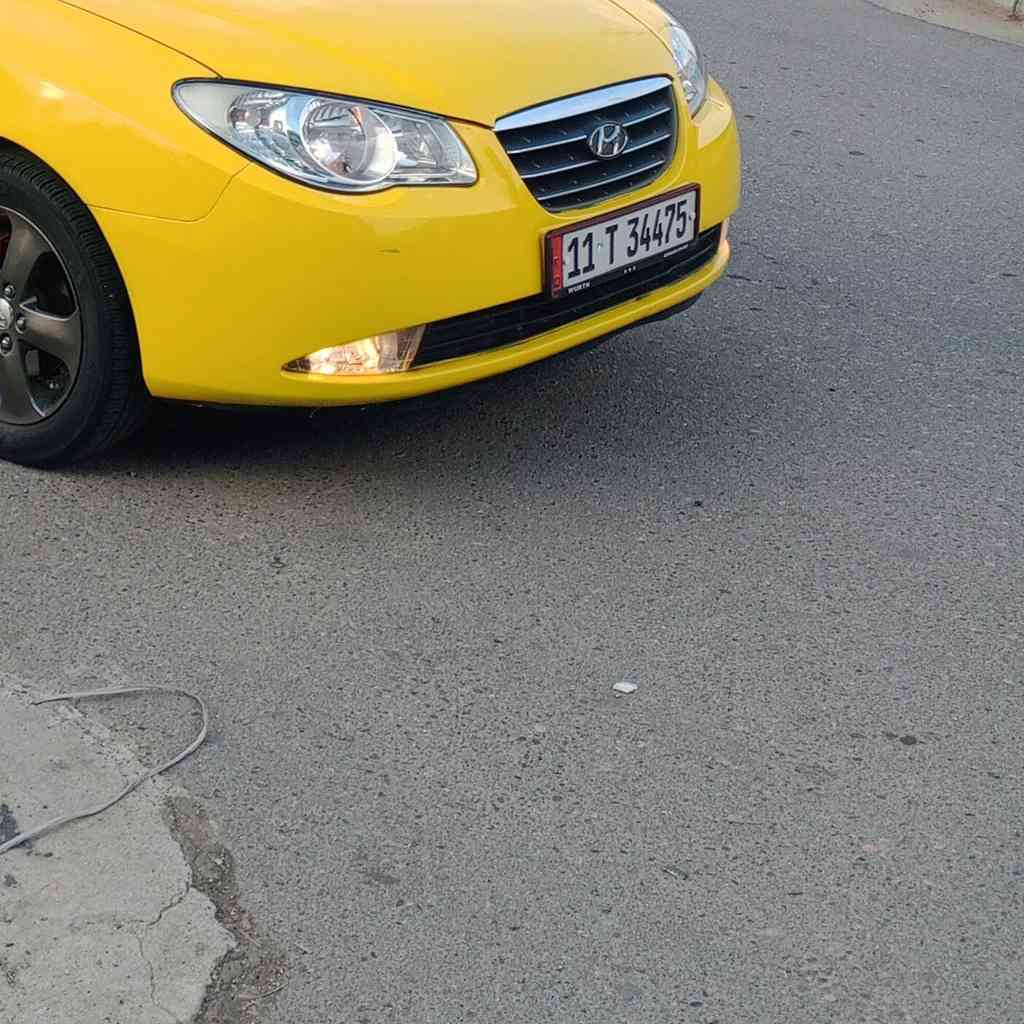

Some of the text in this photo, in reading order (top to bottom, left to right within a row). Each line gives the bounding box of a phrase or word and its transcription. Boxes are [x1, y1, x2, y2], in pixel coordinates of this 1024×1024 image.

[567, 232, 595, 279] 11
[605, 224, 619, 265] T
[627, 199, 688, 258] 34475
